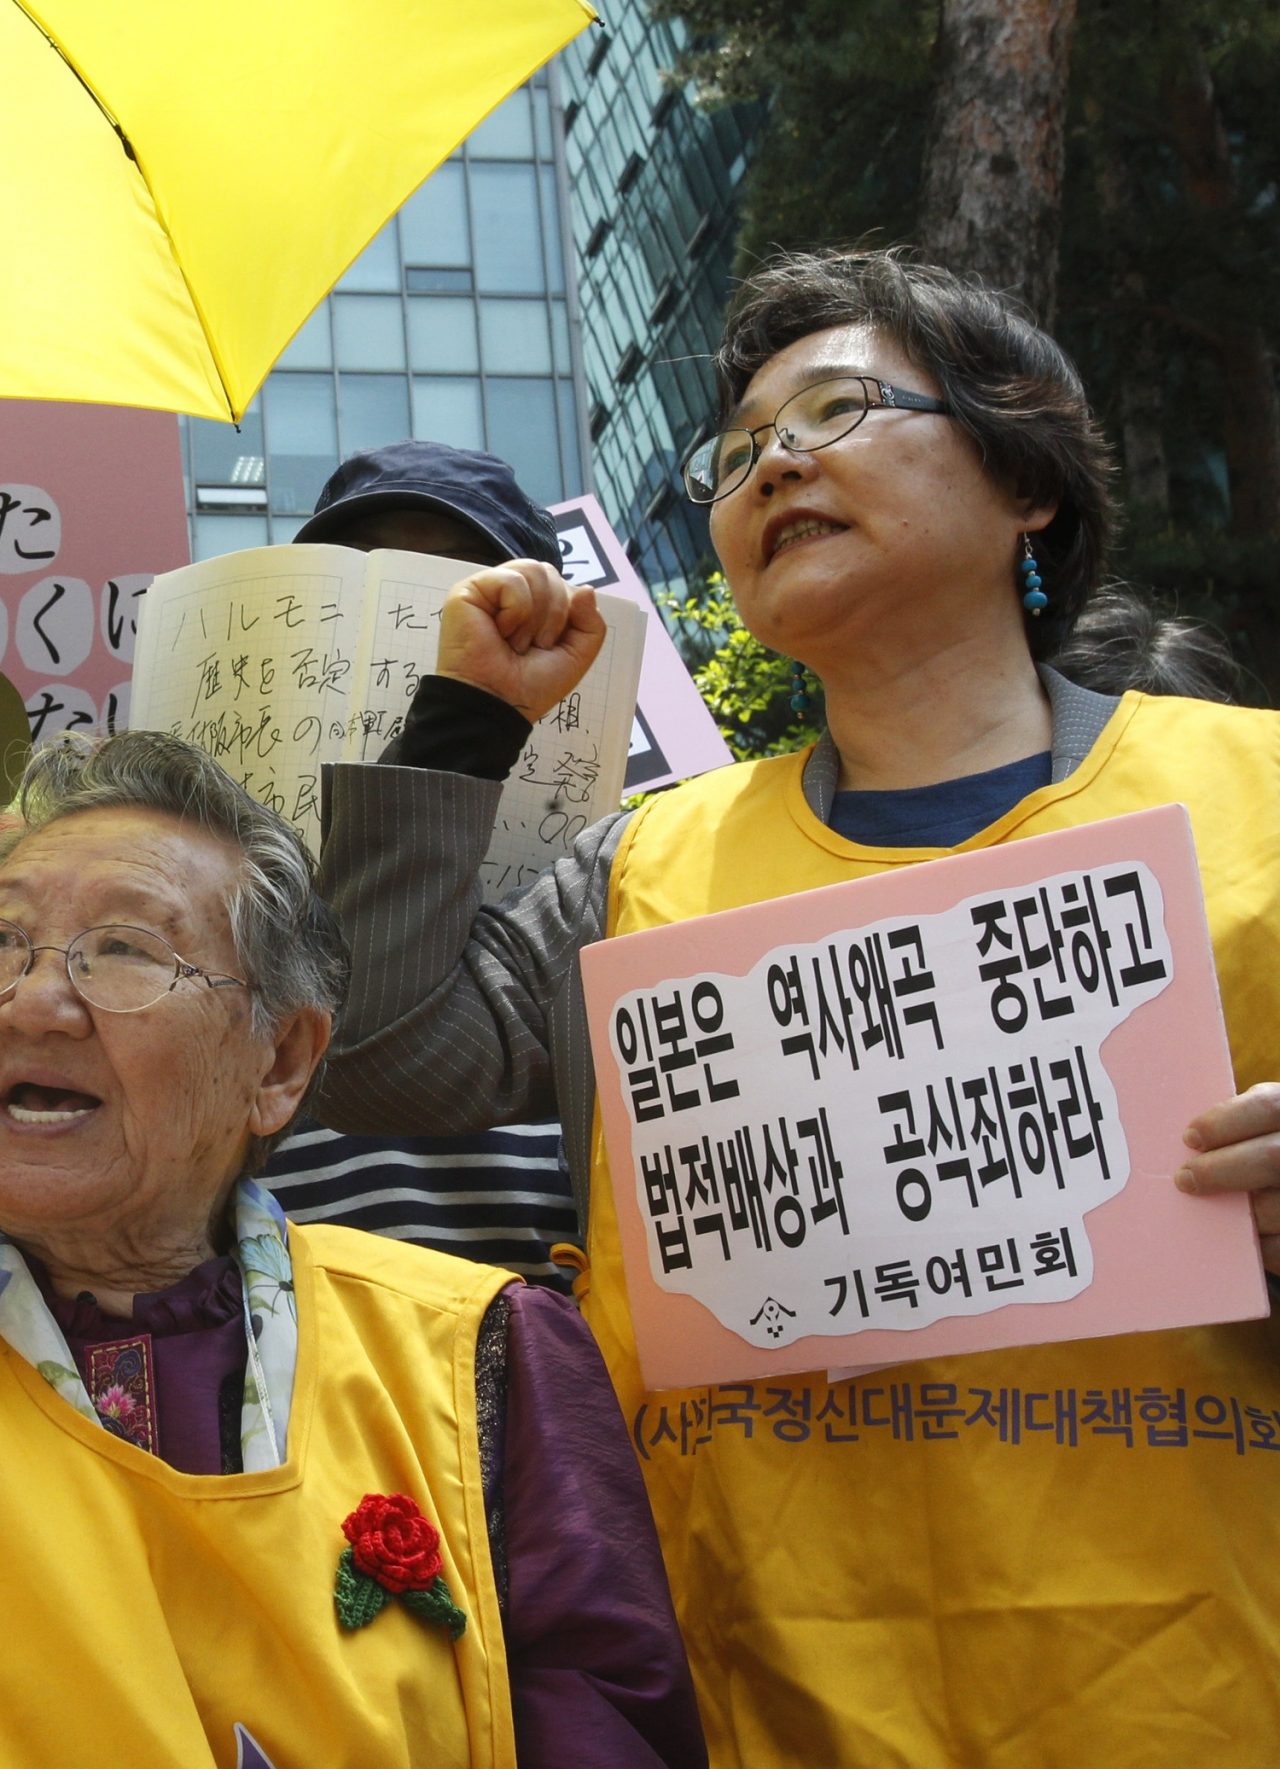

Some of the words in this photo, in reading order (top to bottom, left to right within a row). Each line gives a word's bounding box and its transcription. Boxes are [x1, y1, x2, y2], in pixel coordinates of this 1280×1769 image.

[615, 980, 740, 1123] 일본은
[767, 924, 944, 1081] 역사왜곡
[970, 870, 1167, 1034] 중단하고
[640, 1107, 850, 1275] 법적배상과
[877, 1045, 1111, 1222] 공식죄하라
[824, 1226, 1079, 1319] 기독여민회
